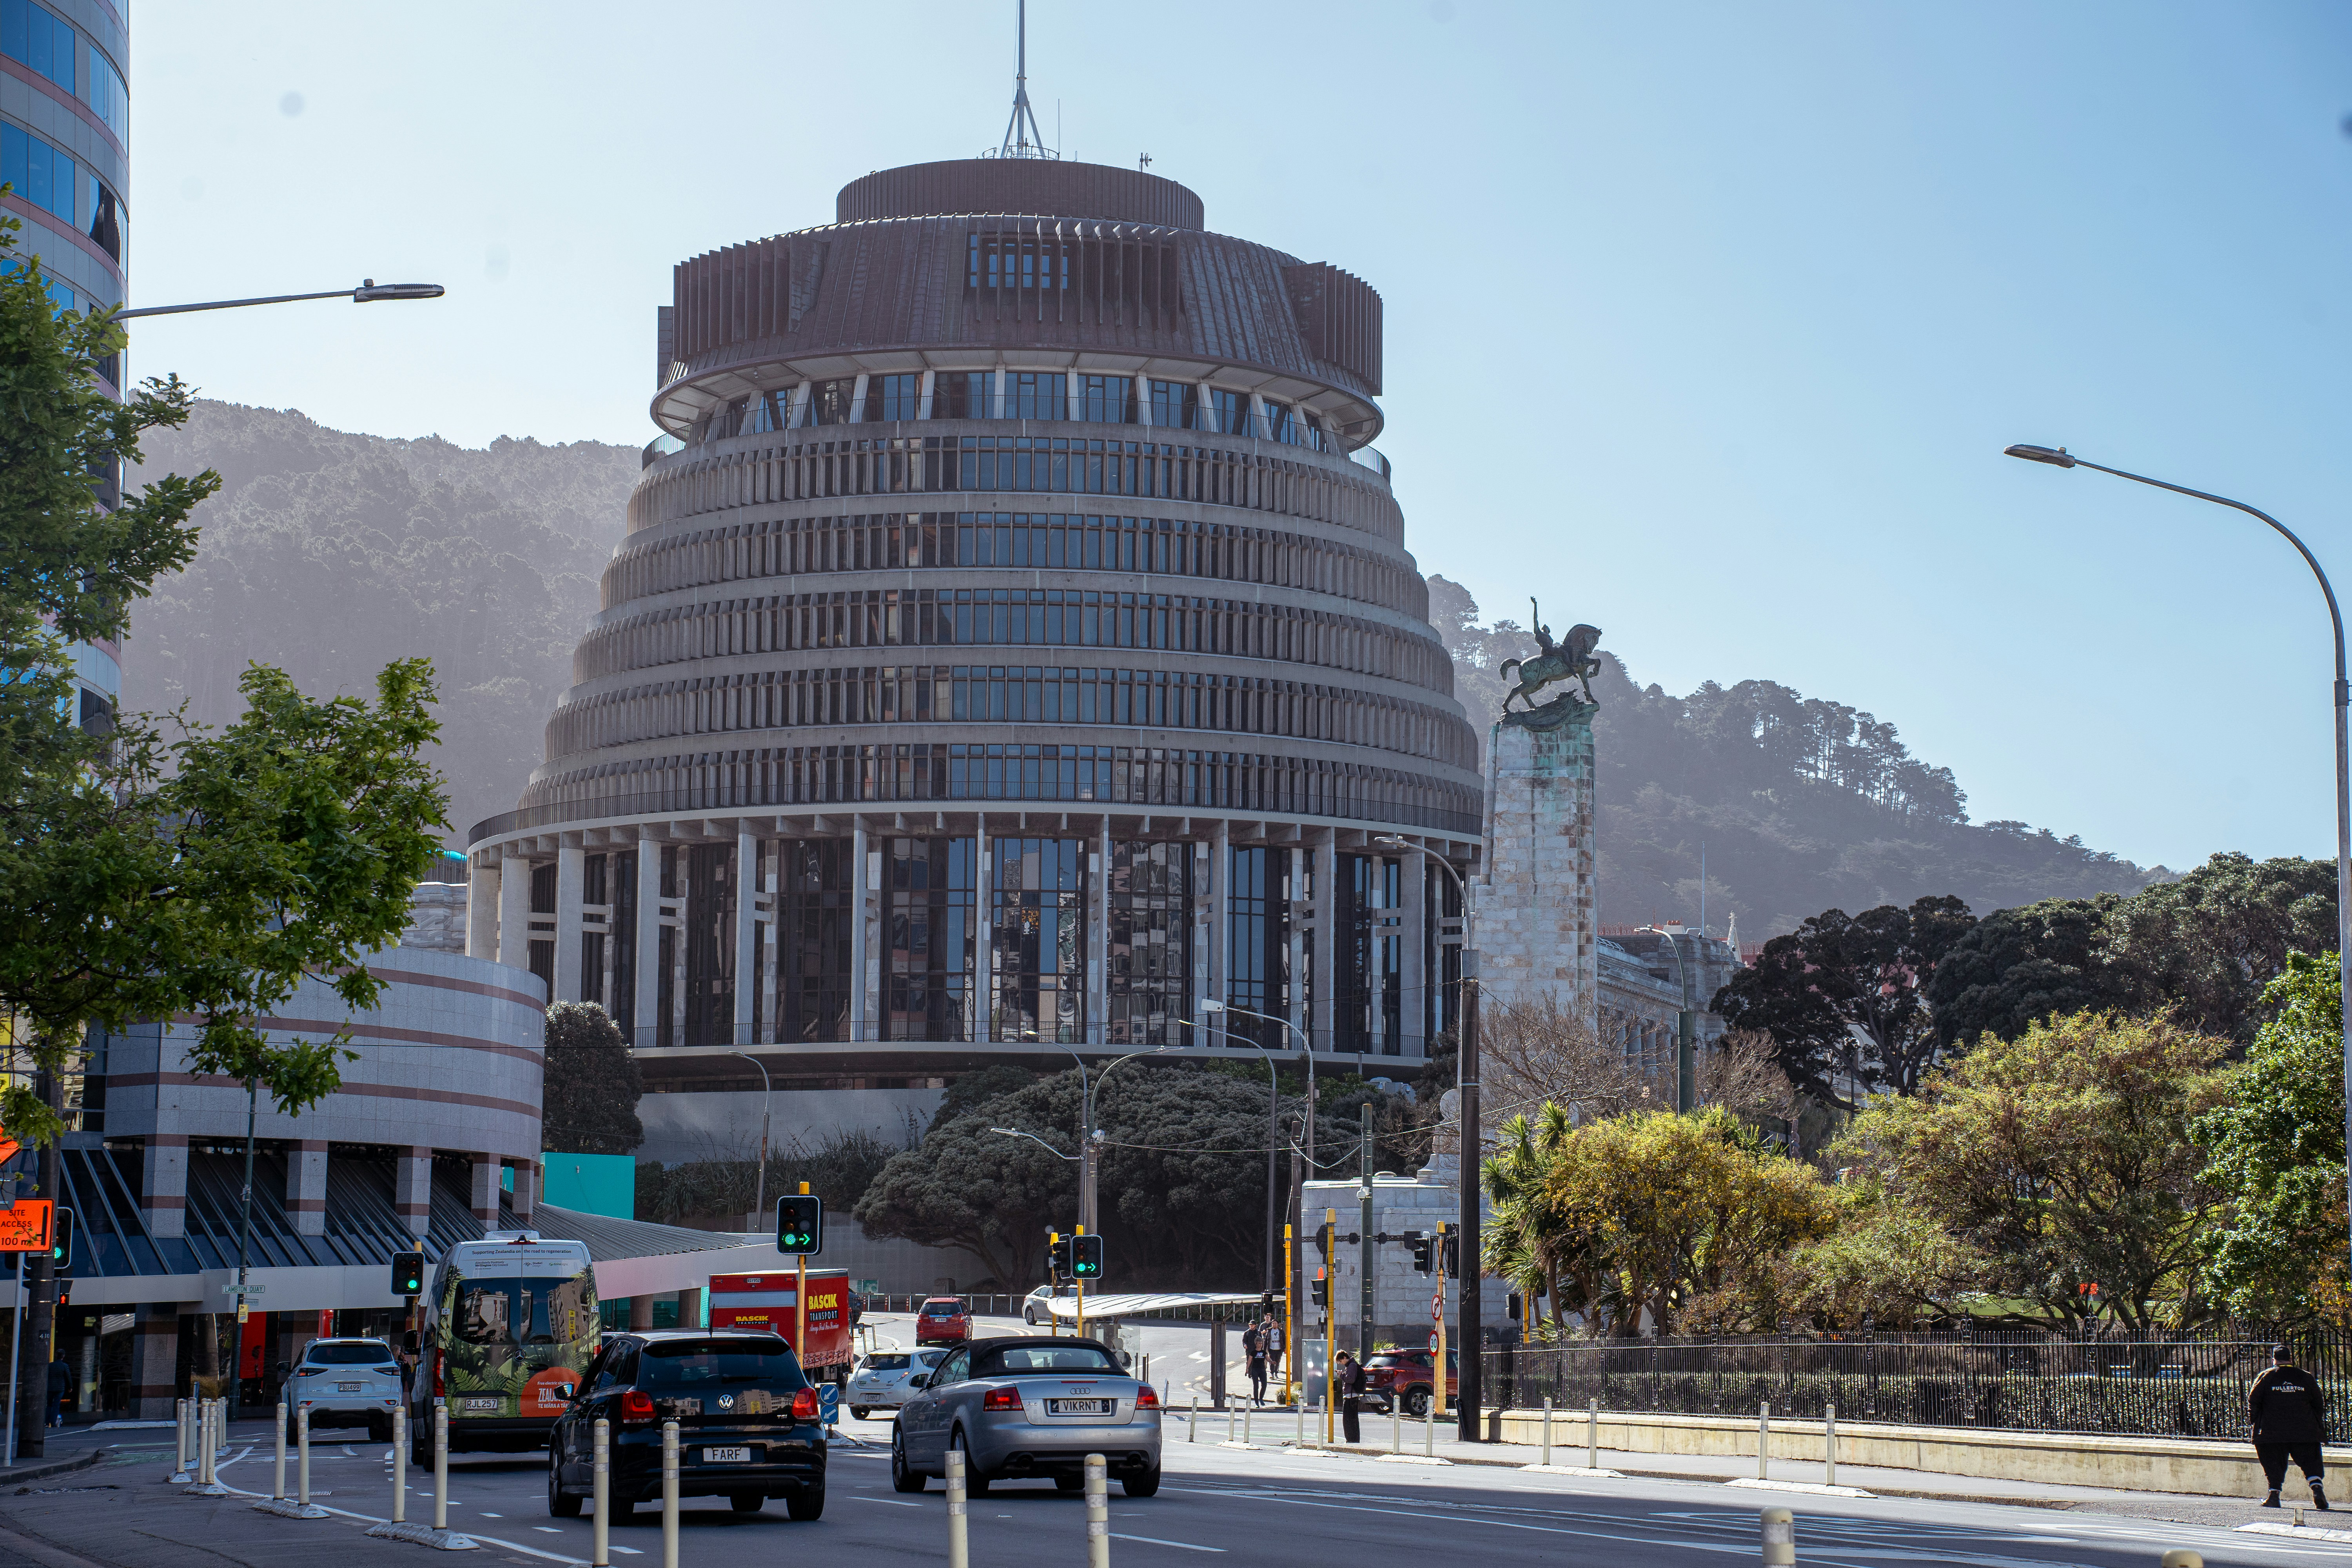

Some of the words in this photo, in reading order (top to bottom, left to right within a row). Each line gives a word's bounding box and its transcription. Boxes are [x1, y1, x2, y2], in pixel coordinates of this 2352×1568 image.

[1, 1237, 18, 1246] 100
[808, 1294, 838, 1310] BASCIK
[810, 1310, 837, 1321] TRANSPORT
[1430, 1338, 1437, 1348] 30
[1063, 1401, 1097, 1411] VIKRNT
[713, 1449, 740, 1460] FARF
